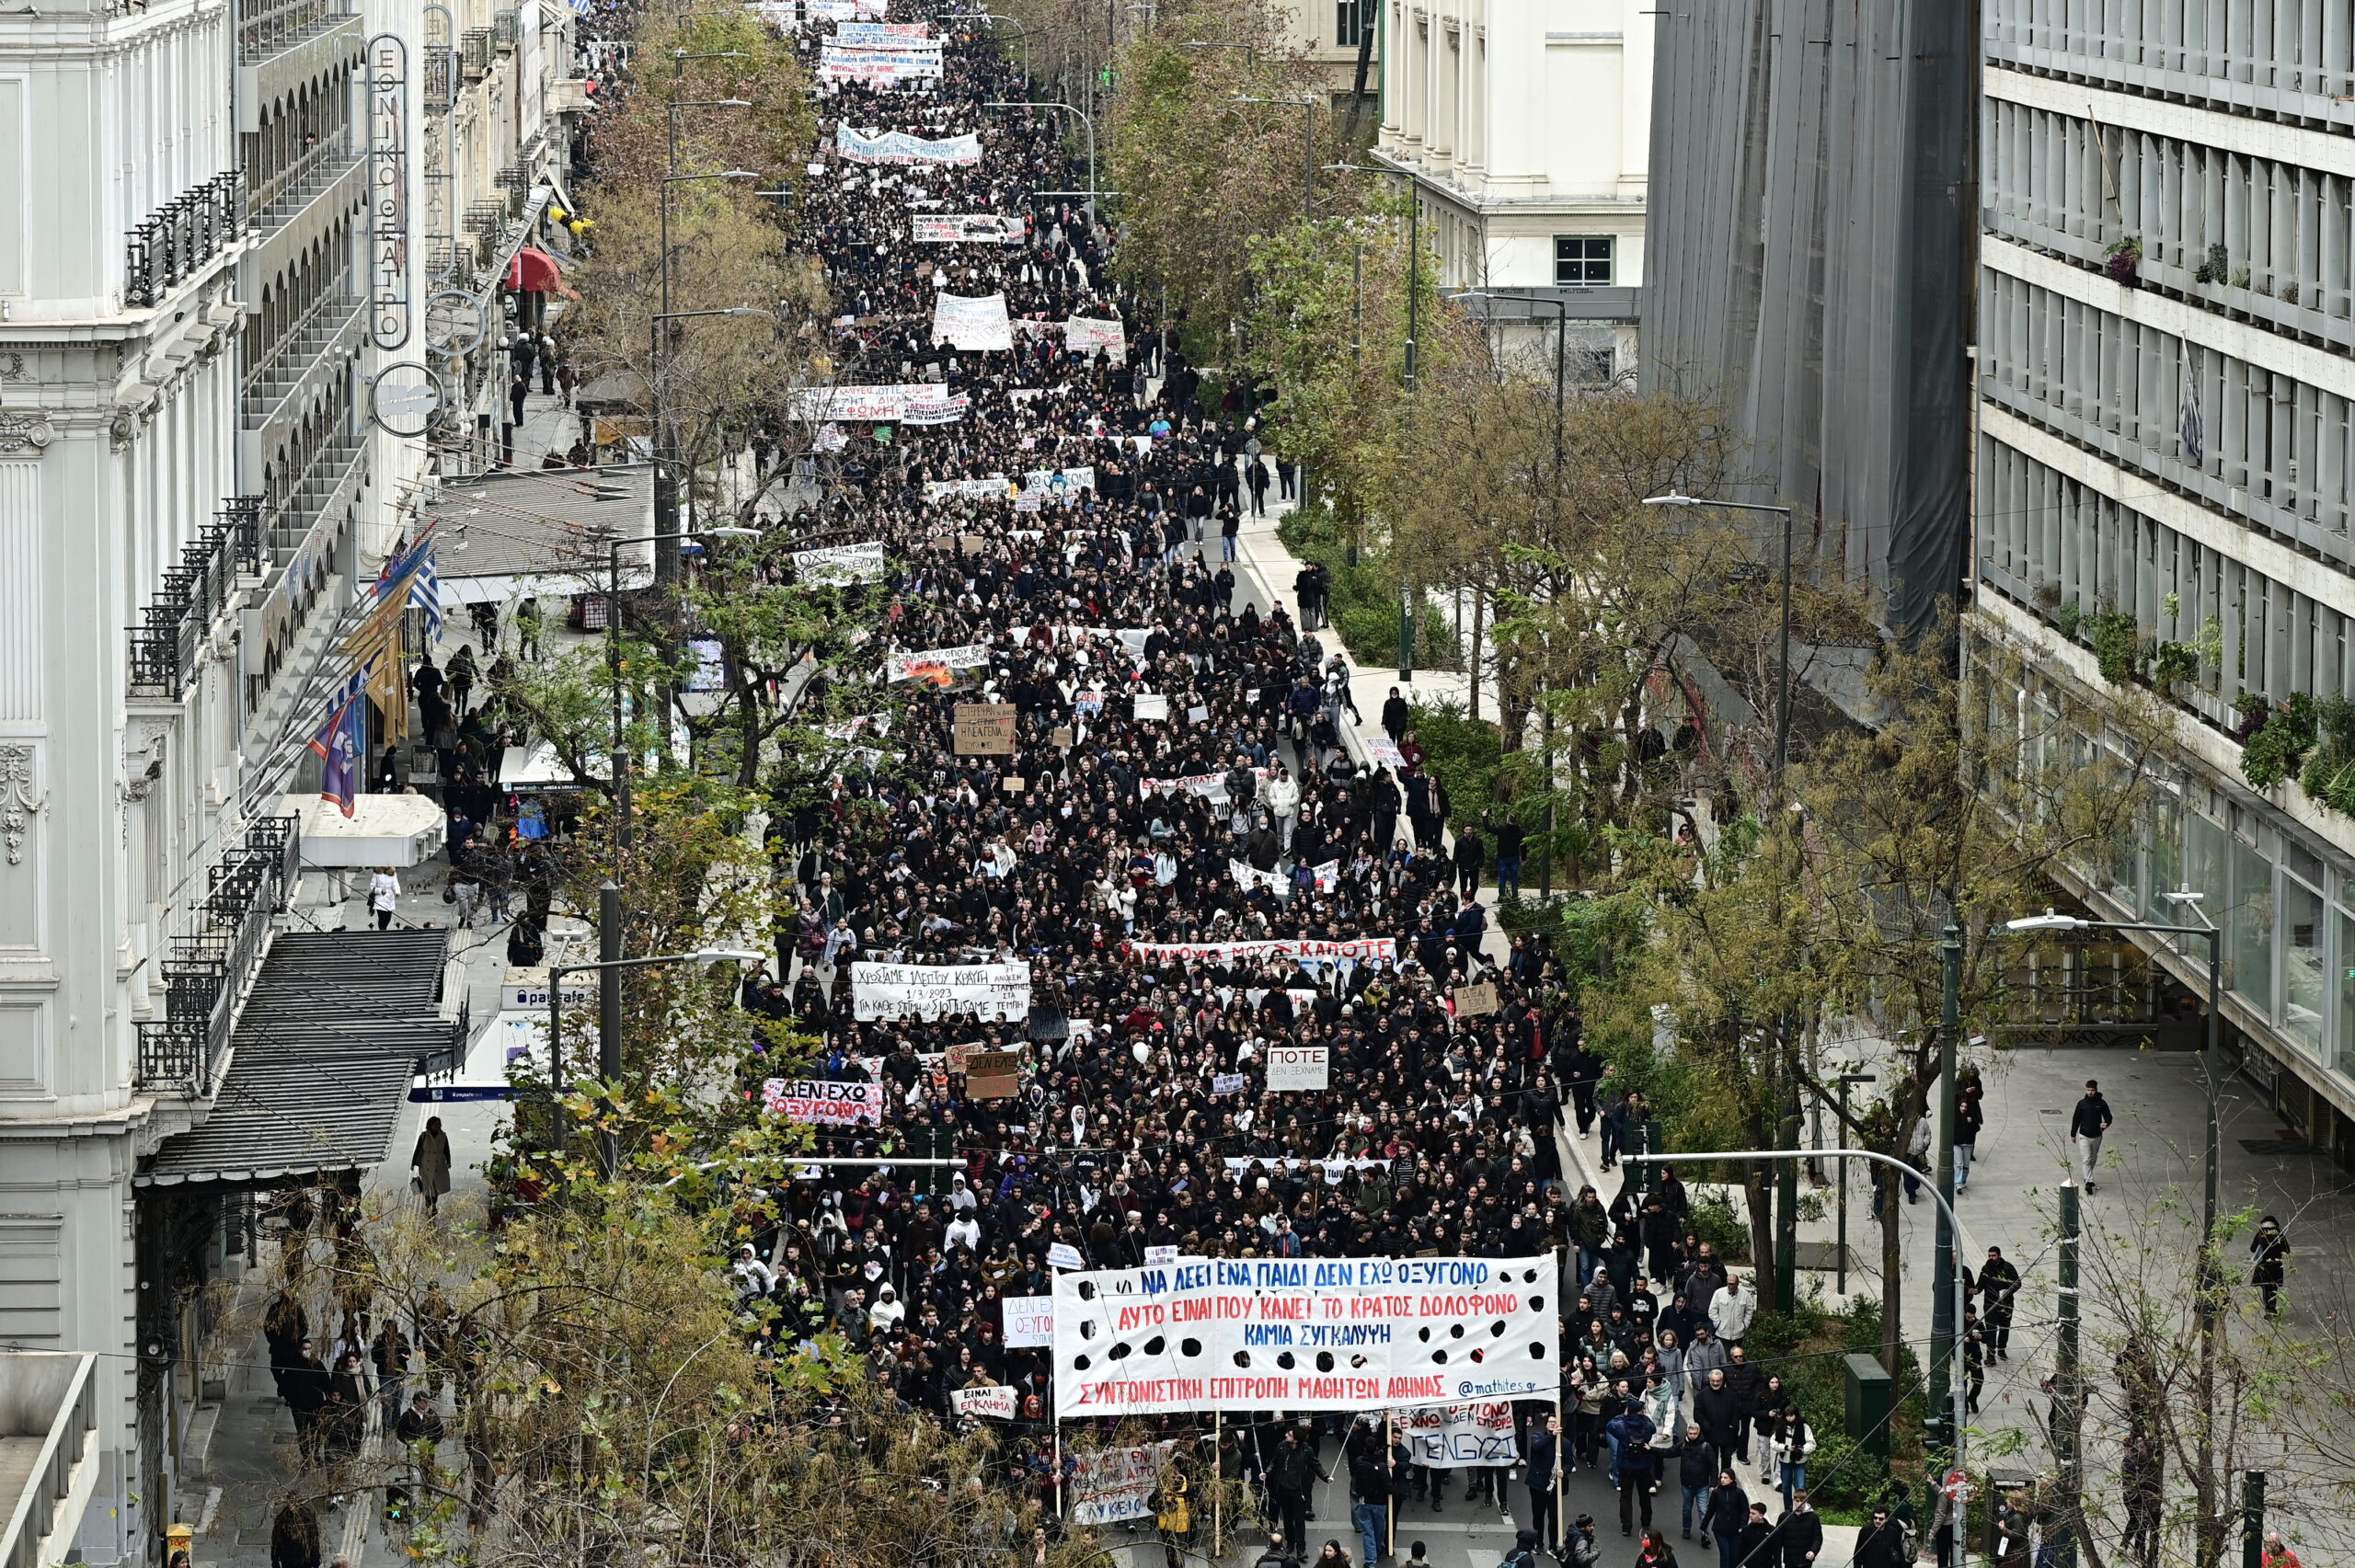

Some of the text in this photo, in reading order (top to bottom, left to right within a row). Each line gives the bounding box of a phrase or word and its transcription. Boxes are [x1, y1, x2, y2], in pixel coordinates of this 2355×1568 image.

[906, 989, 951, 999] 1/3/2023
[873, 999, 894, 1013] ΚΑΘΕ
[996, 1001, 1023, 1011] ΤΕΜΠΗ
[1271, 1050, 1325, 1064] ΠΟΤΕ
[1271, 1067, 1325, 1076] ΔΕΝ ΞΕΧΝΑΜΕ
[781, 1082, 867, 1103] ΔΕΝ ΕΧΩ
[1141, 1261, 1488, 1295] ΝΑ ΛΕΕΙ ΕΝΑ ΠΑΙΔΙ ΔΕΝ ΕΧΩ ΟΞΥΓΟΝΟ
[1008, 1298, 1035, 1315] ΔΕΝ
[1119, 1293, 1518, 1331] ΑΥΤΟ ΕΙΝΑΙ ΠΟΥ ΚΑΝΕΙ ΤΟ ΚΡΑΤΟΣ ΔΟΛΟΦΟΝΟ
[1244, 1324, 1391, 1346] ΚΑΜΙΑ ΣΥΓΚΑΛΥΨΗ
[964, 1389, 992, 1400] ΕΙΝΑΙ
[1078, 1375, 1446, 1405] ΣΥΝΤΟΝΙΣΤΙΚΗ ΕΠΙΤΡΟΠΗ ΜΑΘΗΤΩΝ ΑΘΗΝΑΣ
[960, 1400, 1011, 1413] ΕΓΚΛΗΜΑ
[1453, 1412, 1474, 1425] ΔΕΝ
